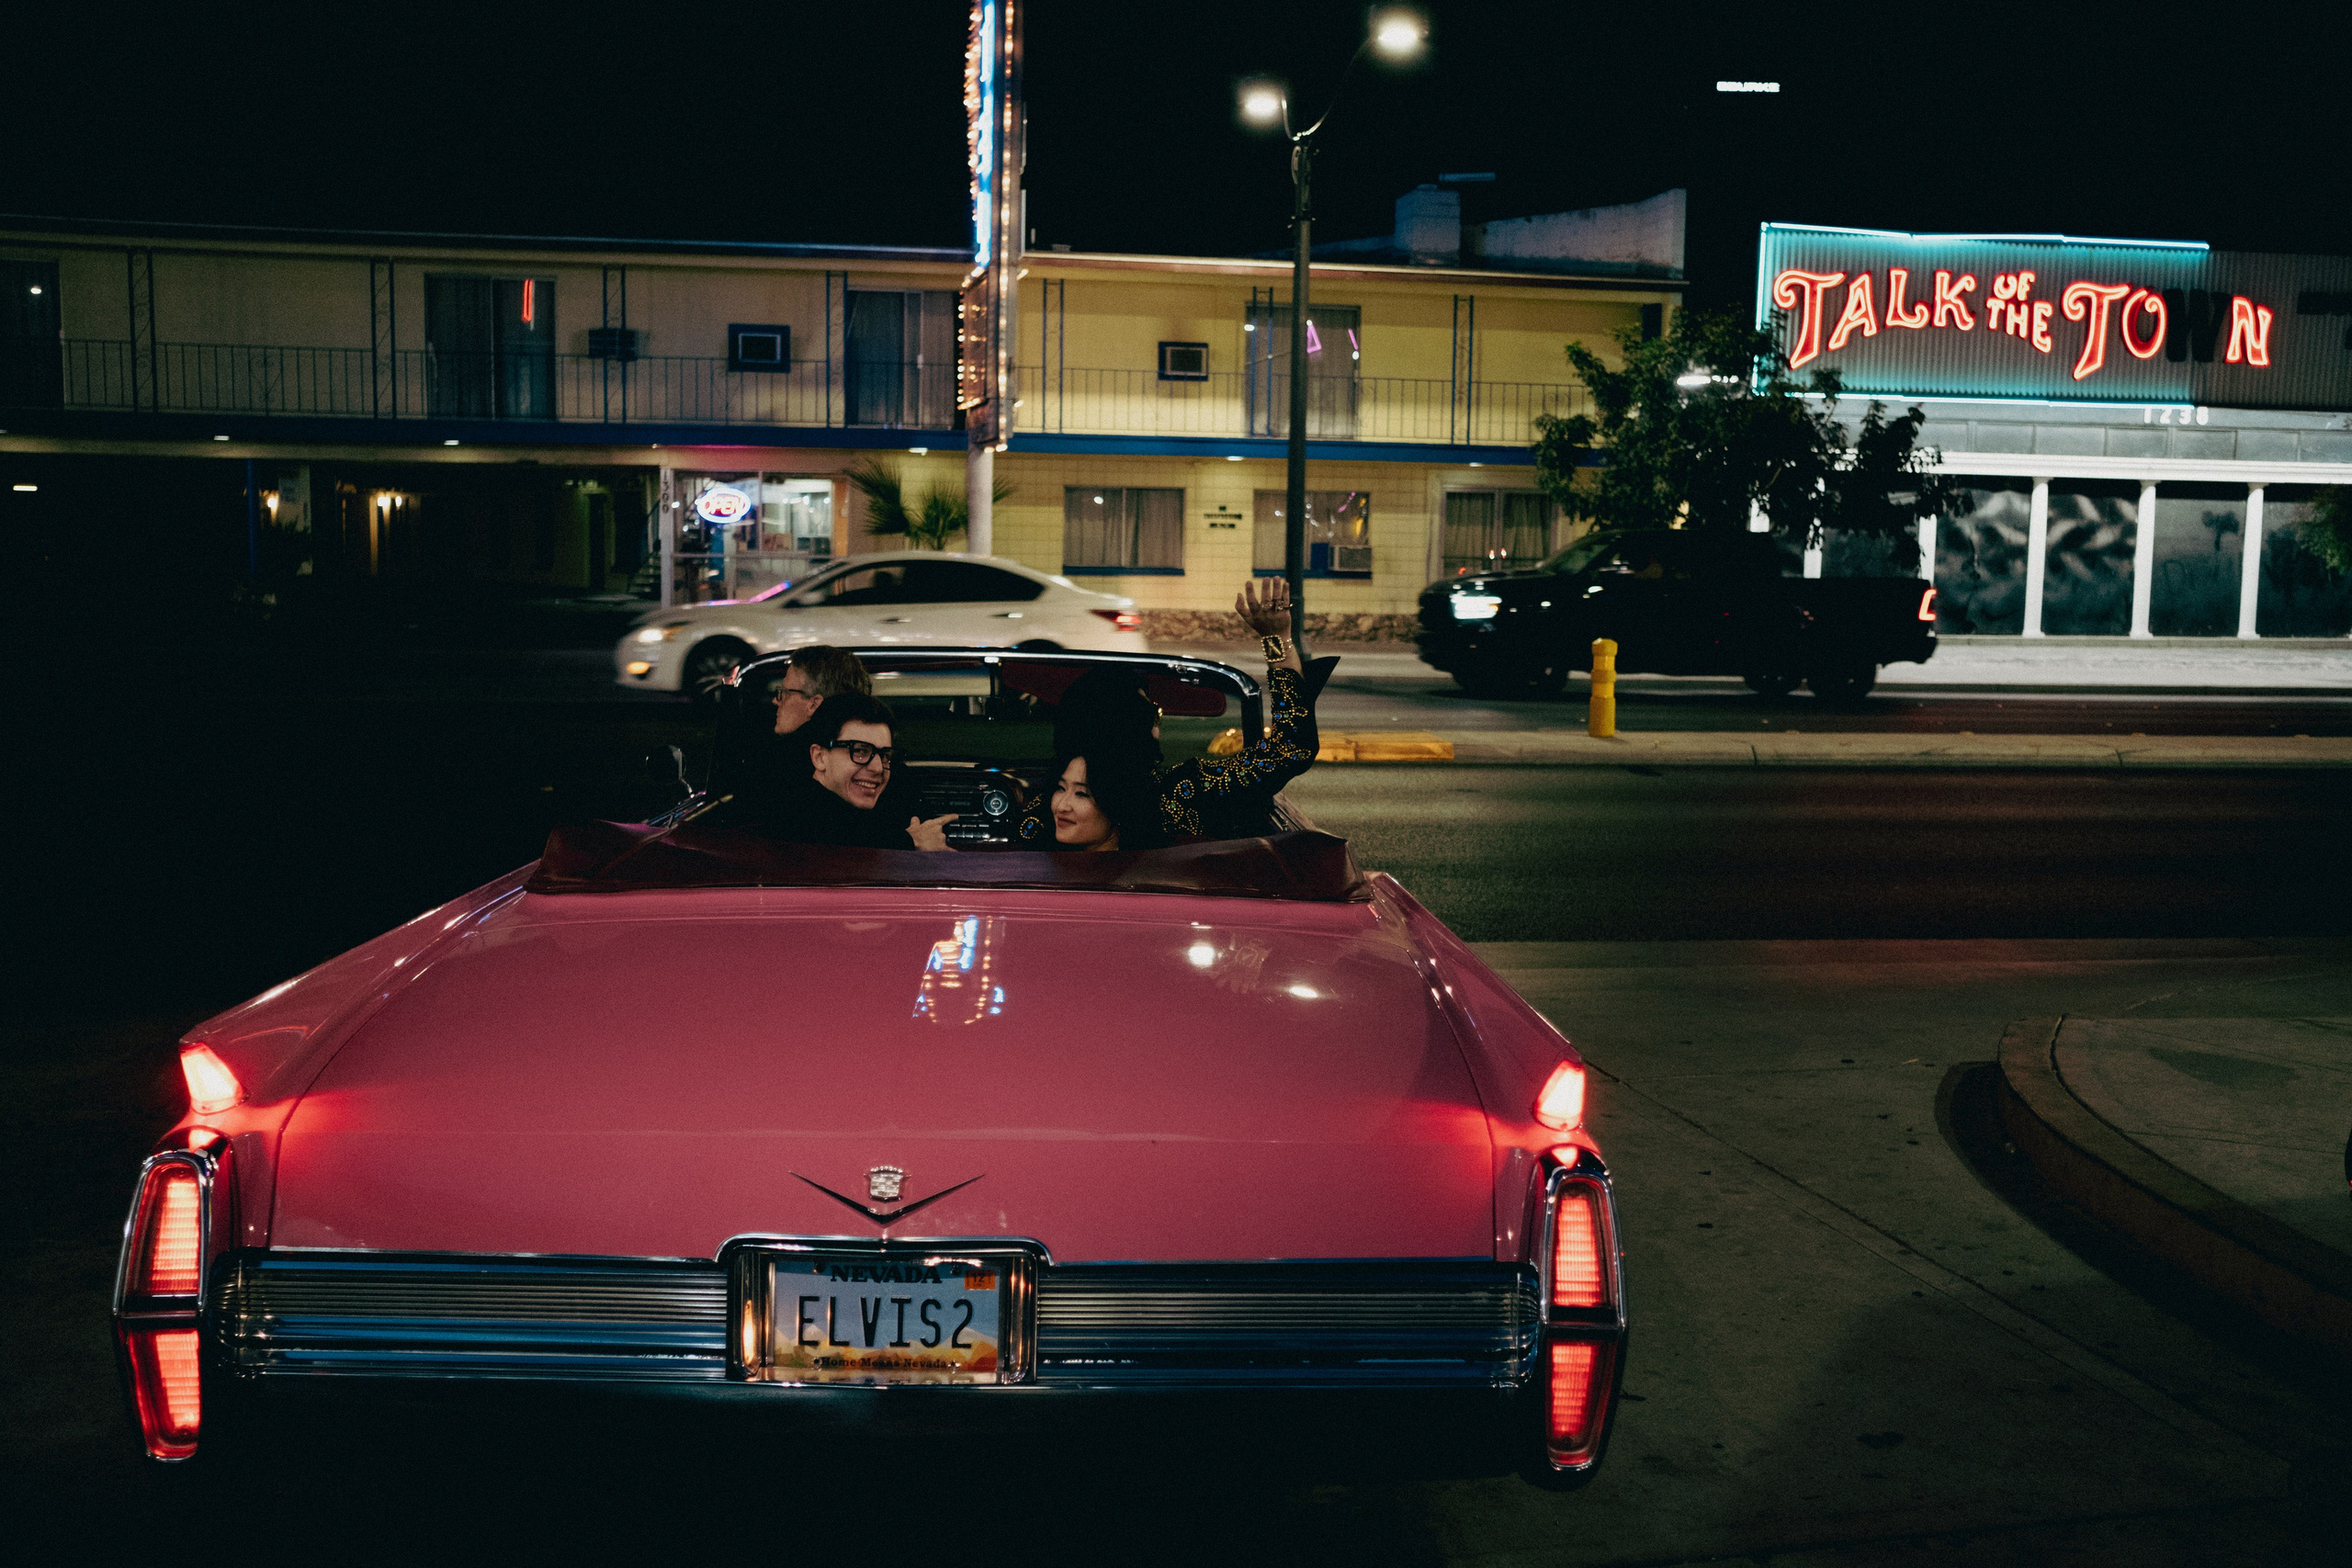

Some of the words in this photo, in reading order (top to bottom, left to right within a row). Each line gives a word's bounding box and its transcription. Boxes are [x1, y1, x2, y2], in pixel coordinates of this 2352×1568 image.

[1993, 270, 2036, 301] OF
[1773, 266, 1977, 369] TALK
[1986, 297, 2053, 354] THE
[2061, 280, 2275, 381] TOWN
[703, 496, 746, 514] OPEN
[830, 1265, 942, 1283] NEVADA
[797, 1296, 974, 1349] ELVIS2
[821, 1357, 856, 1368] Home
[903, 1359, 947, 1370] Nevada
